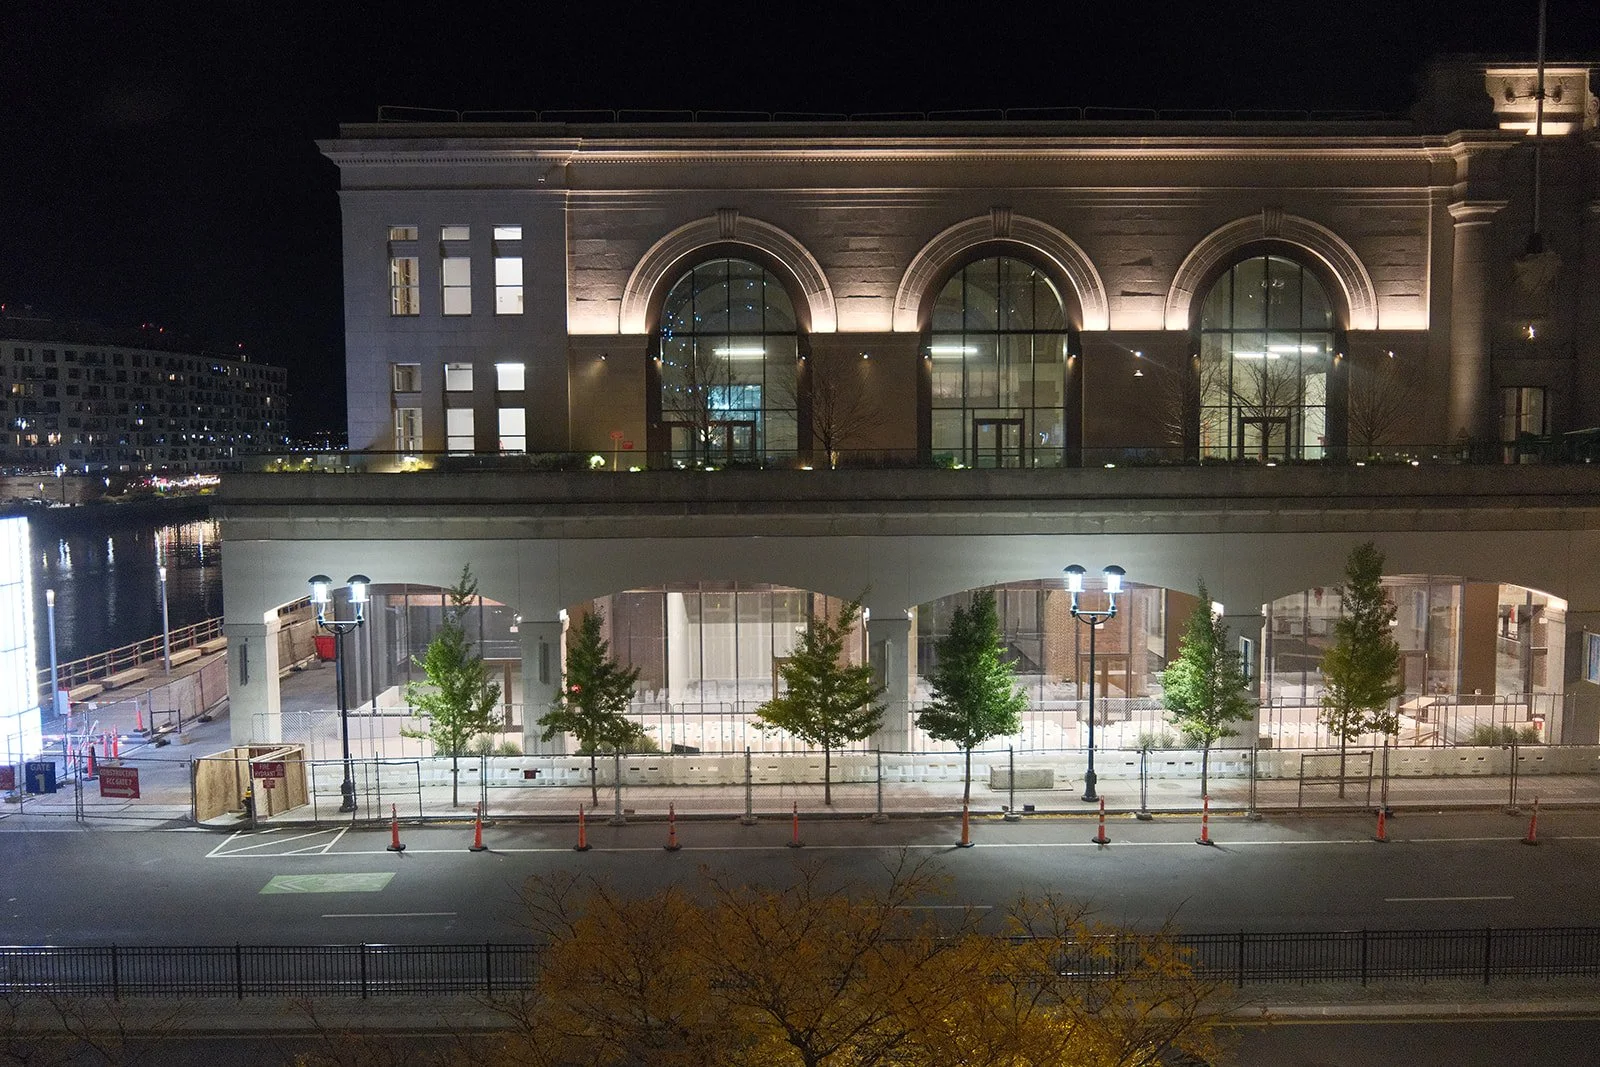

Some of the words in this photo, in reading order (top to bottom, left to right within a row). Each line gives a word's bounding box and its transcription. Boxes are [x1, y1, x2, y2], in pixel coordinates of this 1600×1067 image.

[30, 763, 51, 771] GATE
[99, 768, 138, 777] CONSTRUCTION
[35, 773, 45, 792] 1
